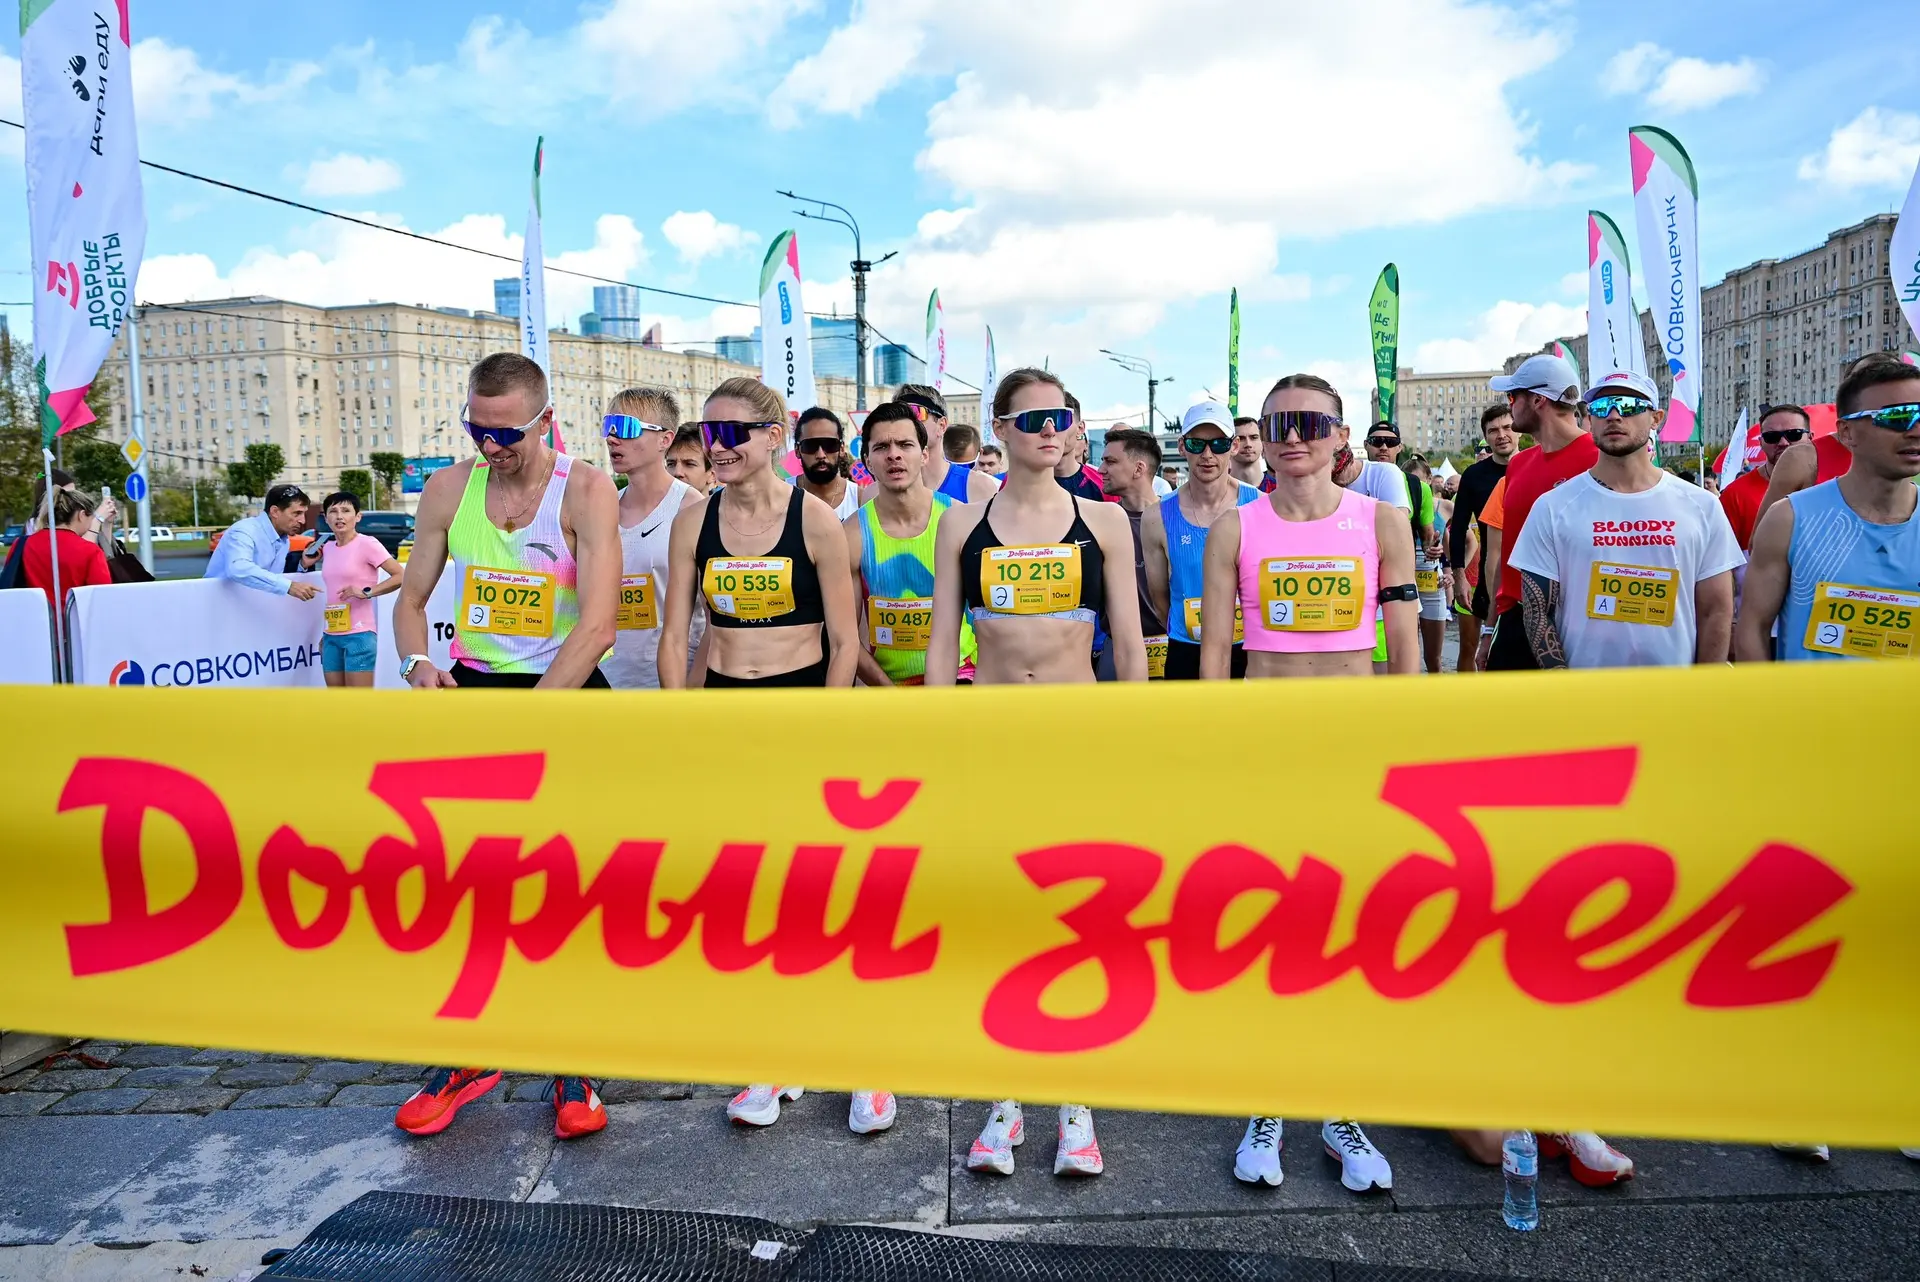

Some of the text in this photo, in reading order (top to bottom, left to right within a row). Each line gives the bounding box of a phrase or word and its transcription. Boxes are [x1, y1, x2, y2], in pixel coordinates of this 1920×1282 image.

[83, 240, 110, 330] ДОБРЫЕ
[1592, 520, 1676, 533] BLOODY
[1592, 535, 1676, 547] RUNNING
[997, 562, 1065, 581] 10 213
[715, 575, 780, 591] 10 535
[1273, 576, 1351, 596] 10 078
[1600, 578, 1666, 598] 10 055
[476, 585, 541, 607] 10 072
[330, 611, 344, 619] 187
[879, 612, 932, 626] 10 487
[1828, 603, 1912, 629] 10 525
[1887, 639, 1909, 648] 10км
[151, 644, 323, 688] СОВКОМБАН
[57, 746, 1857, 1053] Добрый забег
